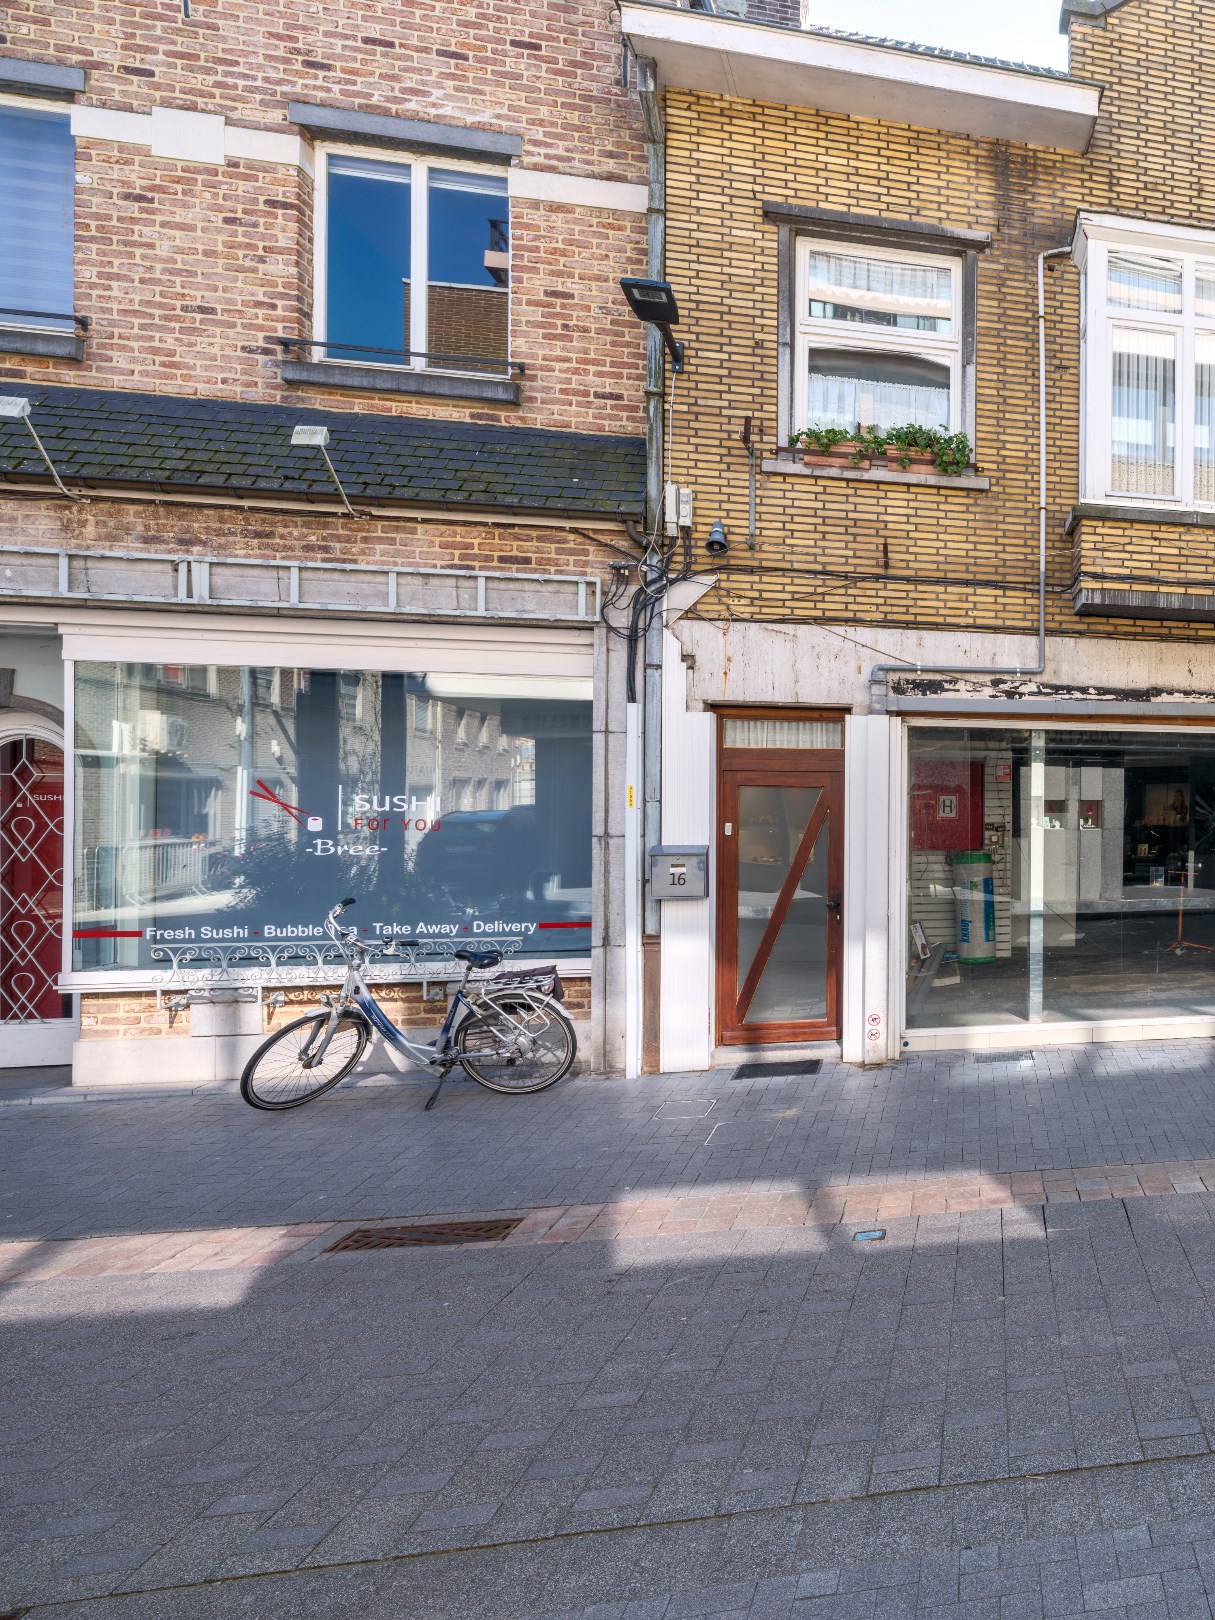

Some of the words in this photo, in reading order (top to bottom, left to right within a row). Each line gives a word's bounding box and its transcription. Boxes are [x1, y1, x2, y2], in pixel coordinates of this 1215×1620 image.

[402, 818, 441, 832] YOU
[669, 872, 686, 886] 16
[146, 927, 195, 939] Fresh
[201, 926, 248, 939] Sushi
[264, 924, 323, 937] Bubble
[373, 922, 411, 935] Take
[416, 922, 459, 936] Away
[473, 920, 537, 934] Delivery
